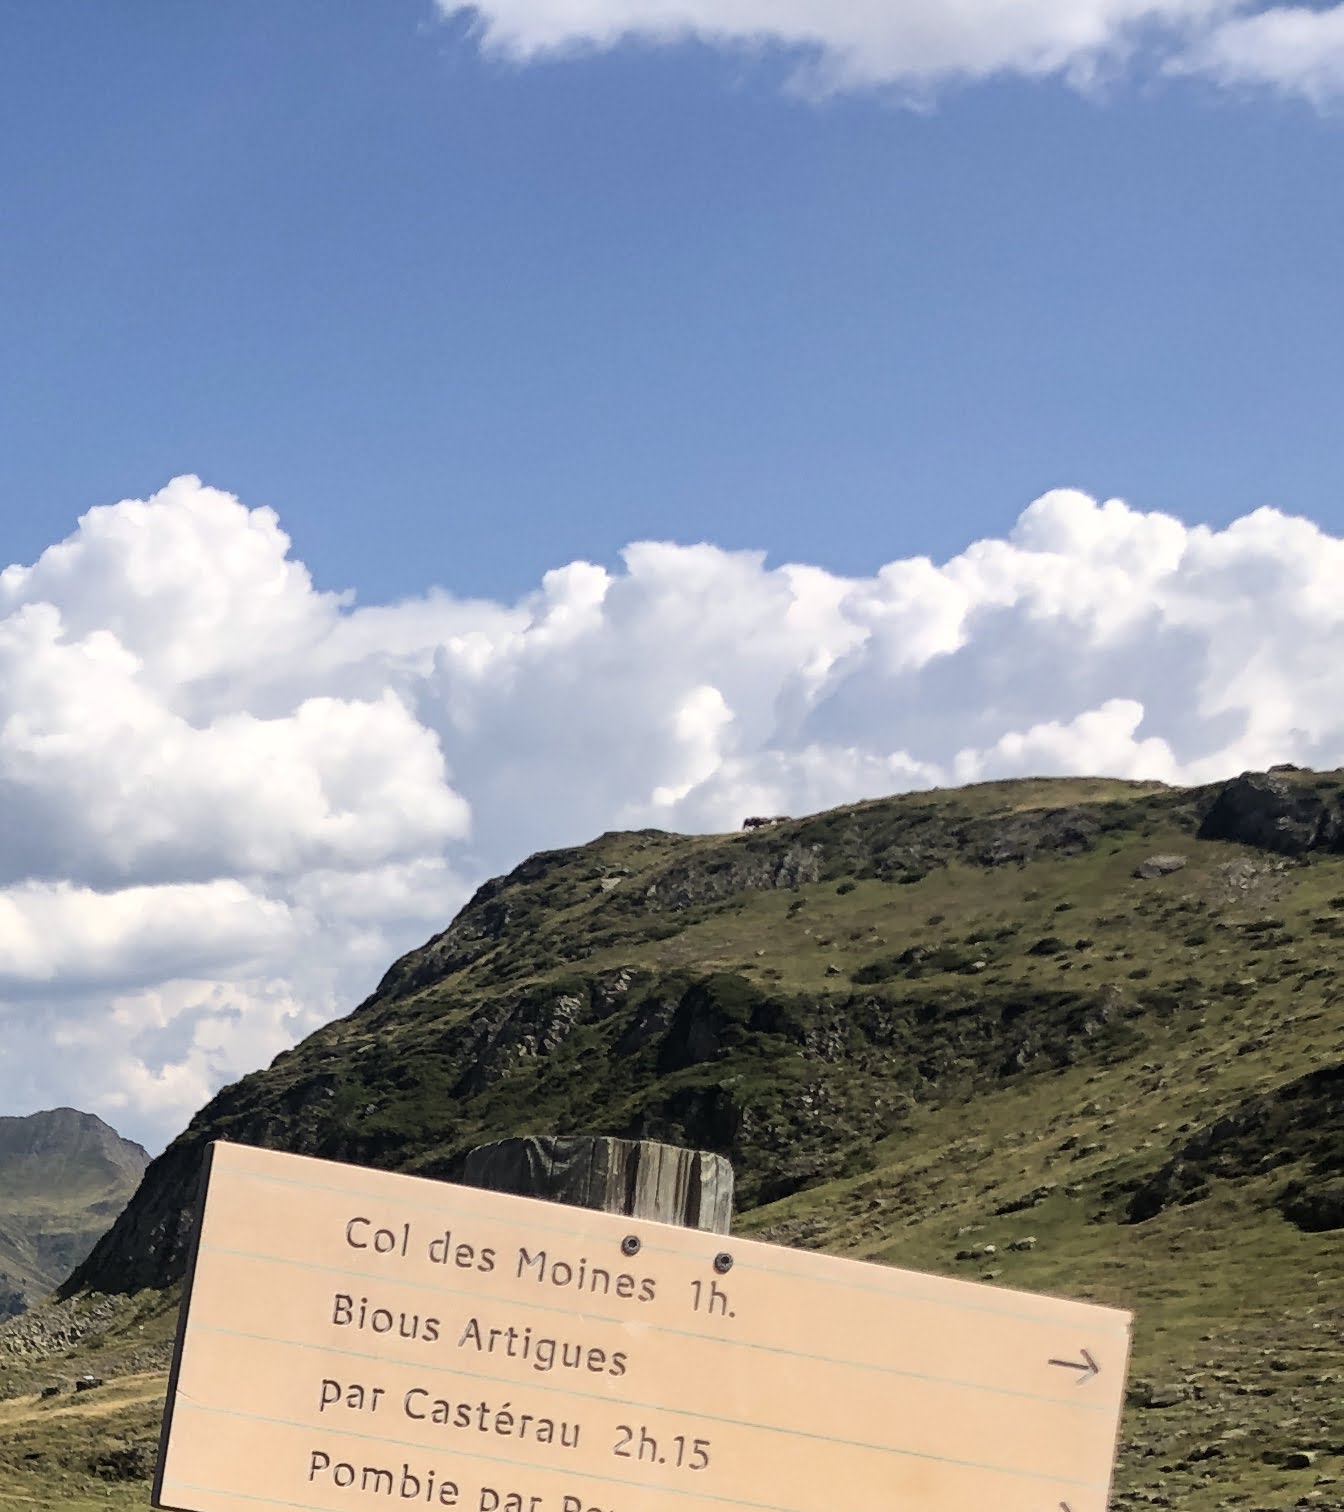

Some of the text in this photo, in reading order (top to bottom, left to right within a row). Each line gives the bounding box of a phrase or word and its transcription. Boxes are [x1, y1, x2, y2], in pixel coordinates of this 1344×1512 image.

[345, 1216, 736, 1318] Col des Moines 1h.
[331, 1293, 628, 1377] Bious Artigues
[318, 1378, 711, 1471] par Castérau 2h.15
[308, 1450, 459, 1507] Pombie
